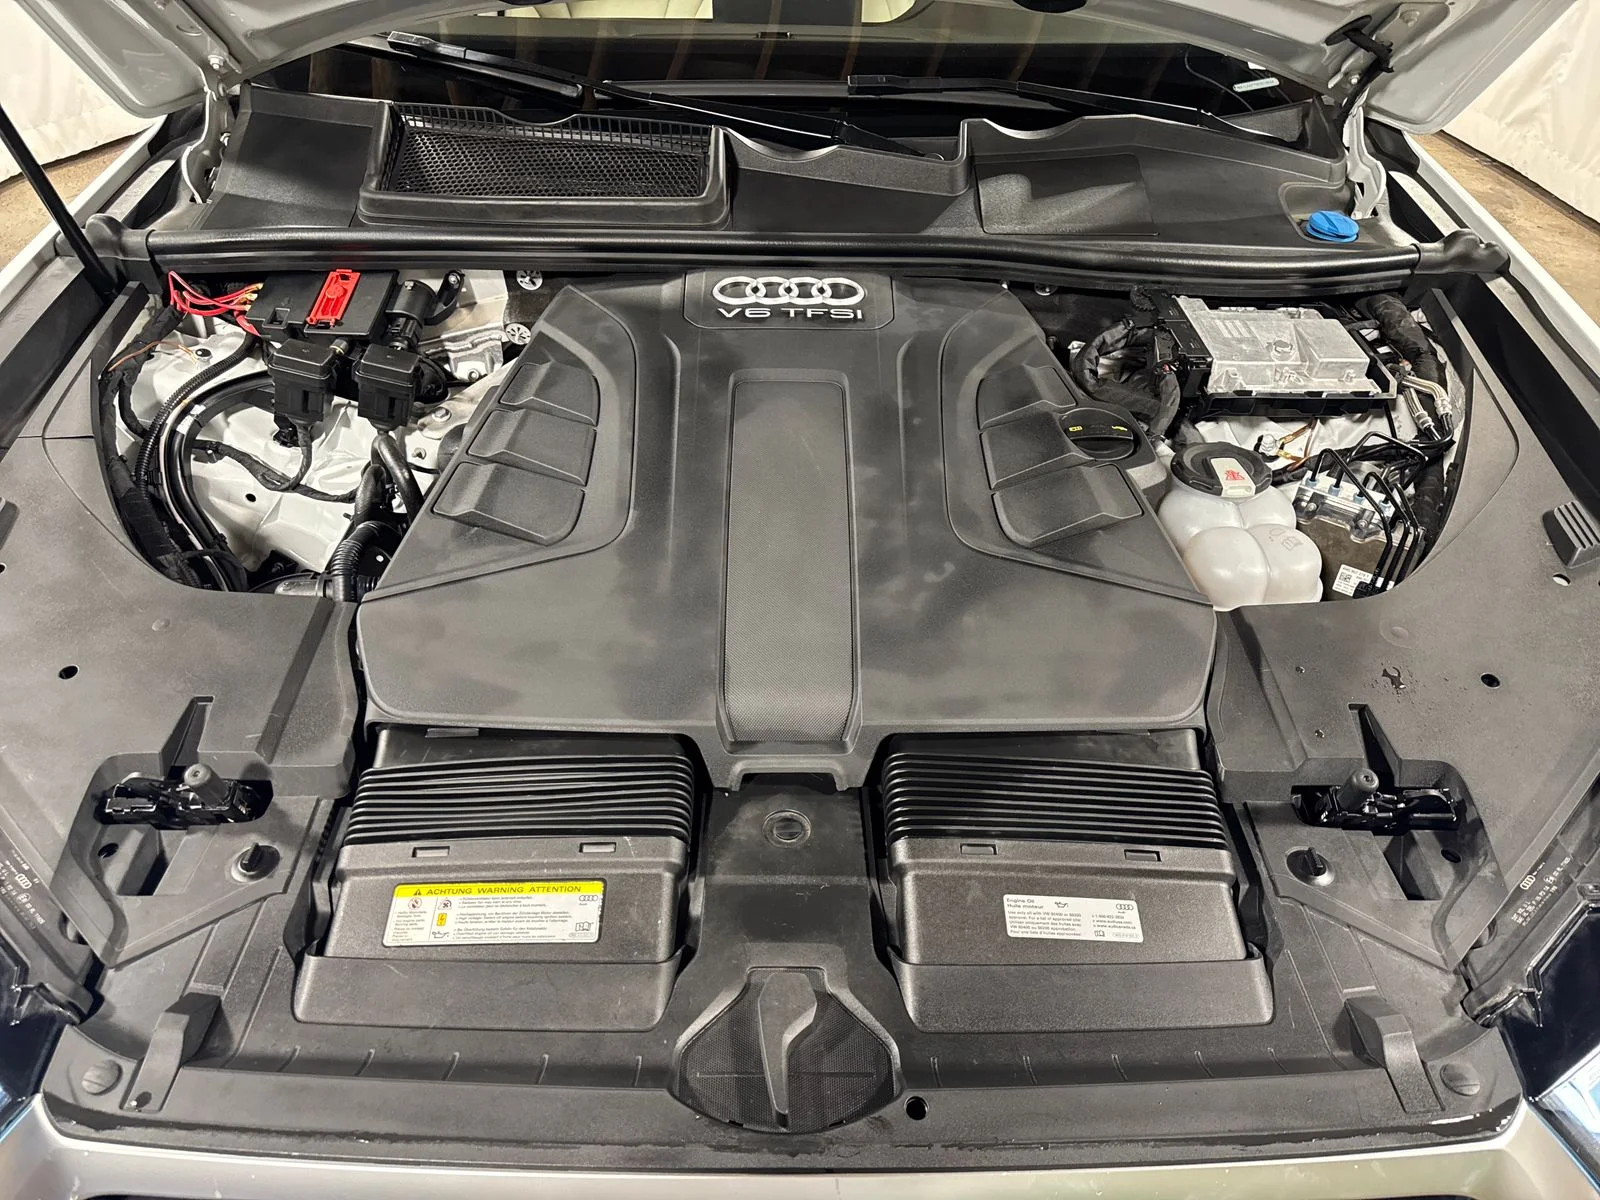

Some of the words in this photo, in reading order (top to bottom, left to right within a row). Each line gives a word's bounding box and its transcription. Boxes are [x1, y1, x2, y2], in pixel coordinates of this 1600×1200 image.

[717, 307, 771, 318] V6
[781, 307, 863, 319] TFSI
[426, 887, 472, 895] ACHTUNG
[477, 886, 524, 894] WARNING
[529, 885, 581, 893] ATTENTION
